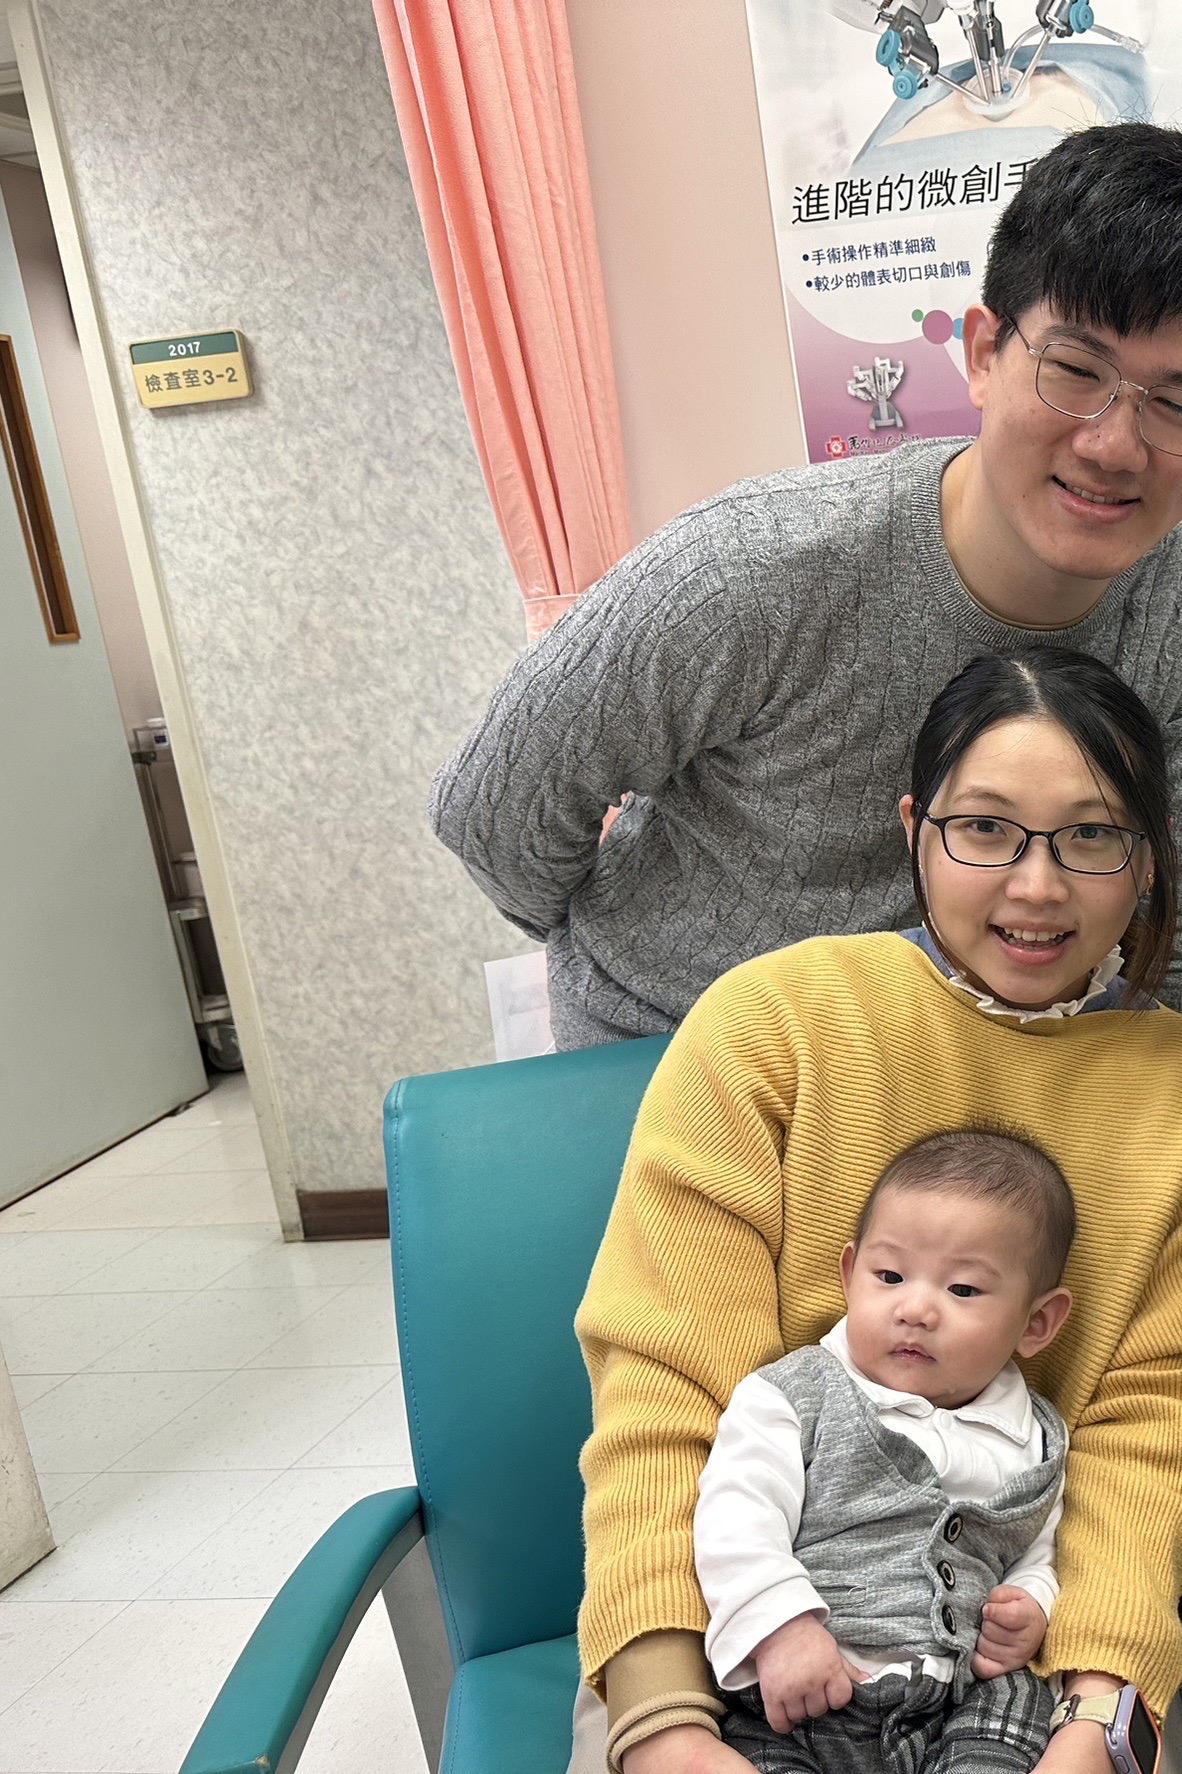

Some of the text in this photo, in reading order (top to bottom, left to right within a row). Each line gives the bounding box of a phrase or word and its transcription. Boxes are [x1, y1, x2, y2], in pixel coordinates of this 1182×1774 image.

[811, 236, 937, 266] 手術操作精準細緻
[814, 260, 971, 292] 較少的體表切口與創傷
[167, 341, 202, 357] 2017
[145, 366, 239, 394] 檢查室3-2
